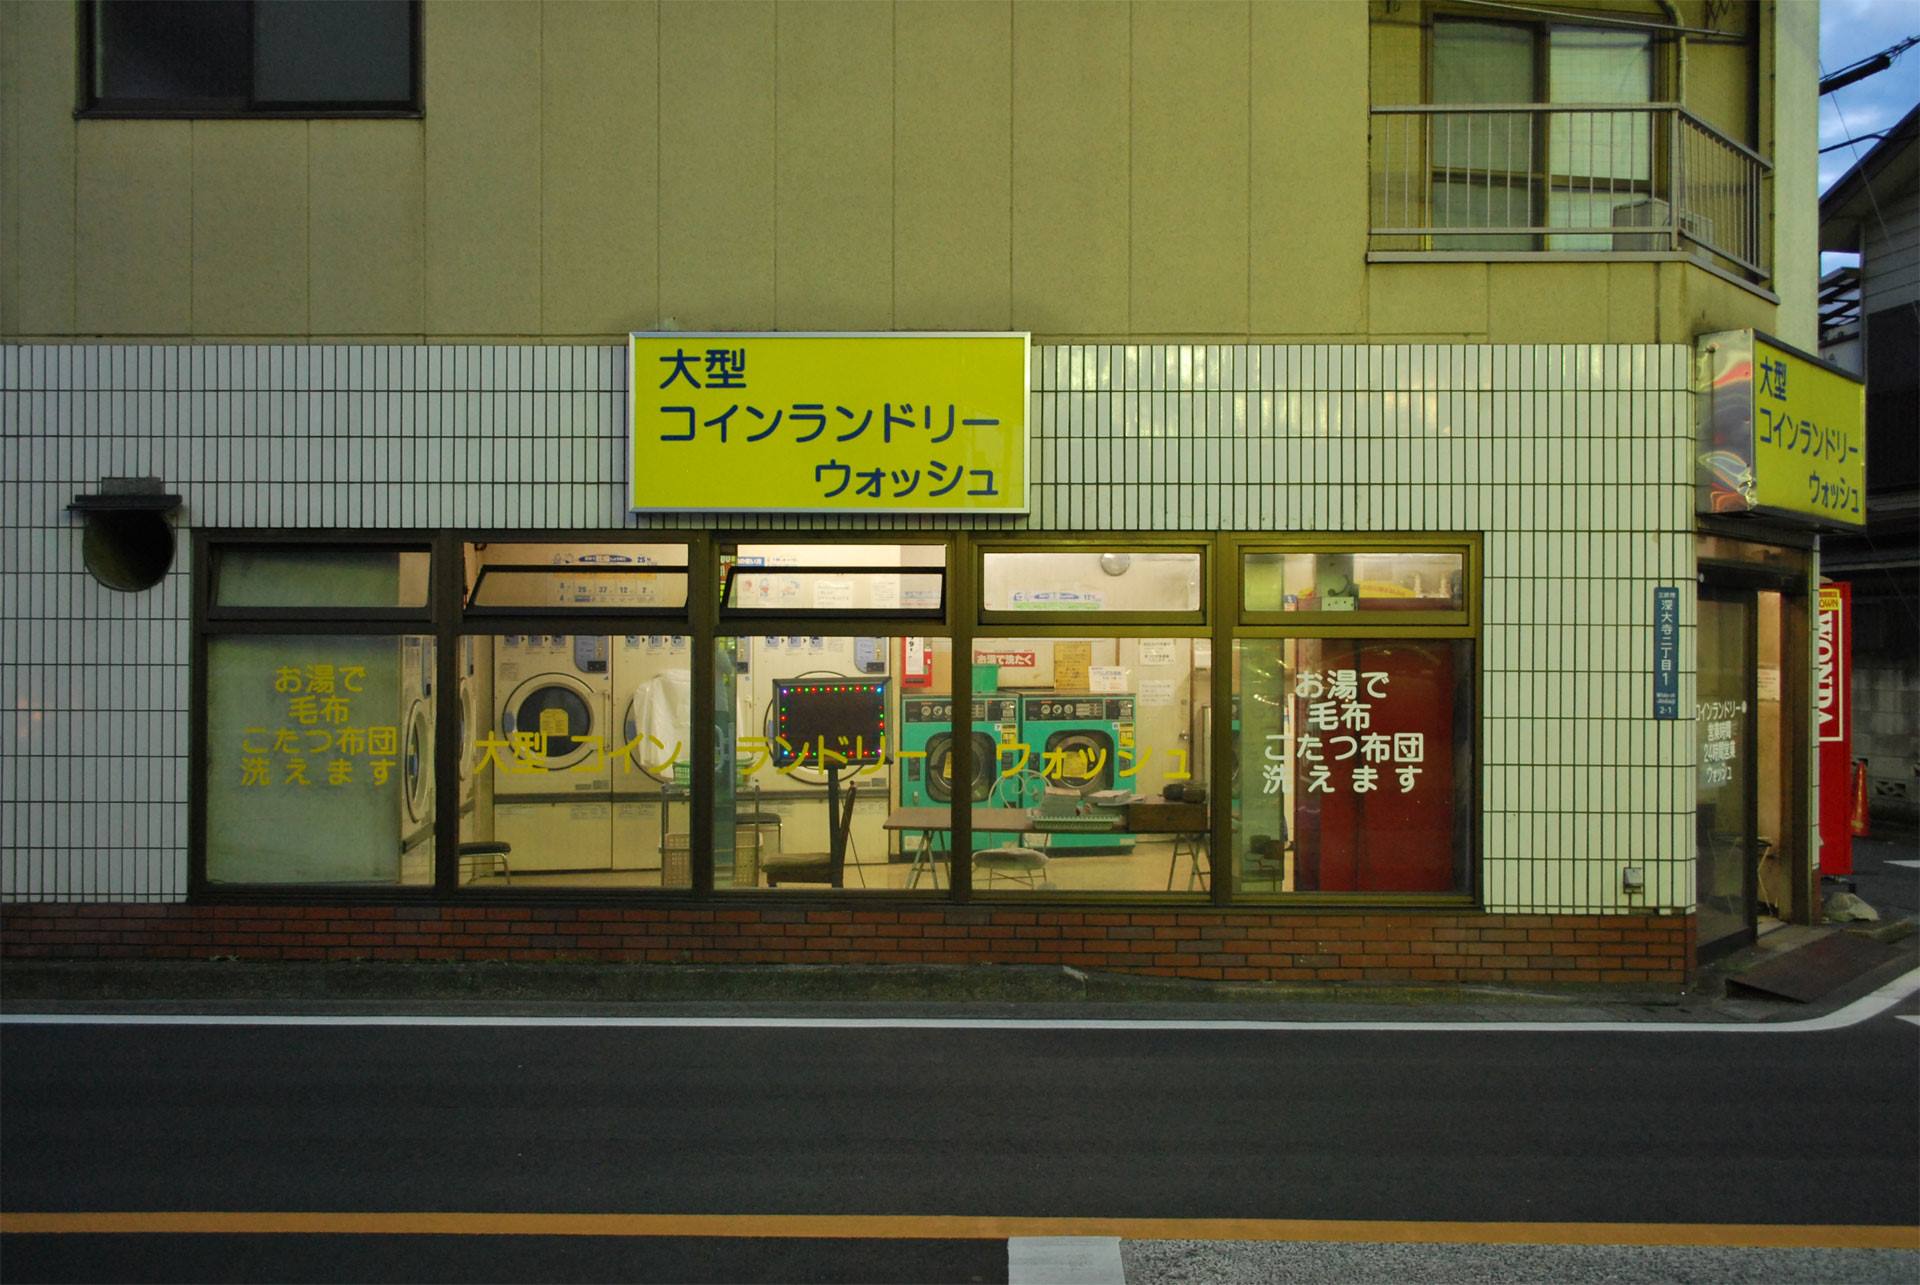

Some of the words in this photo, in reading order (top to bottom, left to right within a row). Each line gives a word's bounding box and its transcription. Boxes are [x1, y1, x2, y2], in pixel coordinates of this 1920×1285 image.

[659, 348, 747, 389] 大型
[1760, 356, 1788, 401] 大型
[660, 403, 1000, 443] コインランドリー
[1760, 407, 1858, 463] コインランドリー
[815, 458, 999, 498] ウォッシュ
[1809, 470, 1860, 513] ウォッシュ
[275, 664, 367, 694] お湯で
[1295, 669, 1390, 700] お湯で
[287, 695, 353, 725] 毛布
[1308, 701, 1372, 732] 毛布
[1696, 700, 1742, 721] コインランドリー
[241, 726, 398, 756] こたつ布団
[473, 730, 550, 774] 大型
[996, 743, 1191, 780] ウォッシュ
[1264, 732, 1424, 764] こたつ布団
[240, 757, 397, 786] 洗えます
[1262, 764, 1423, 794] 洗えます
